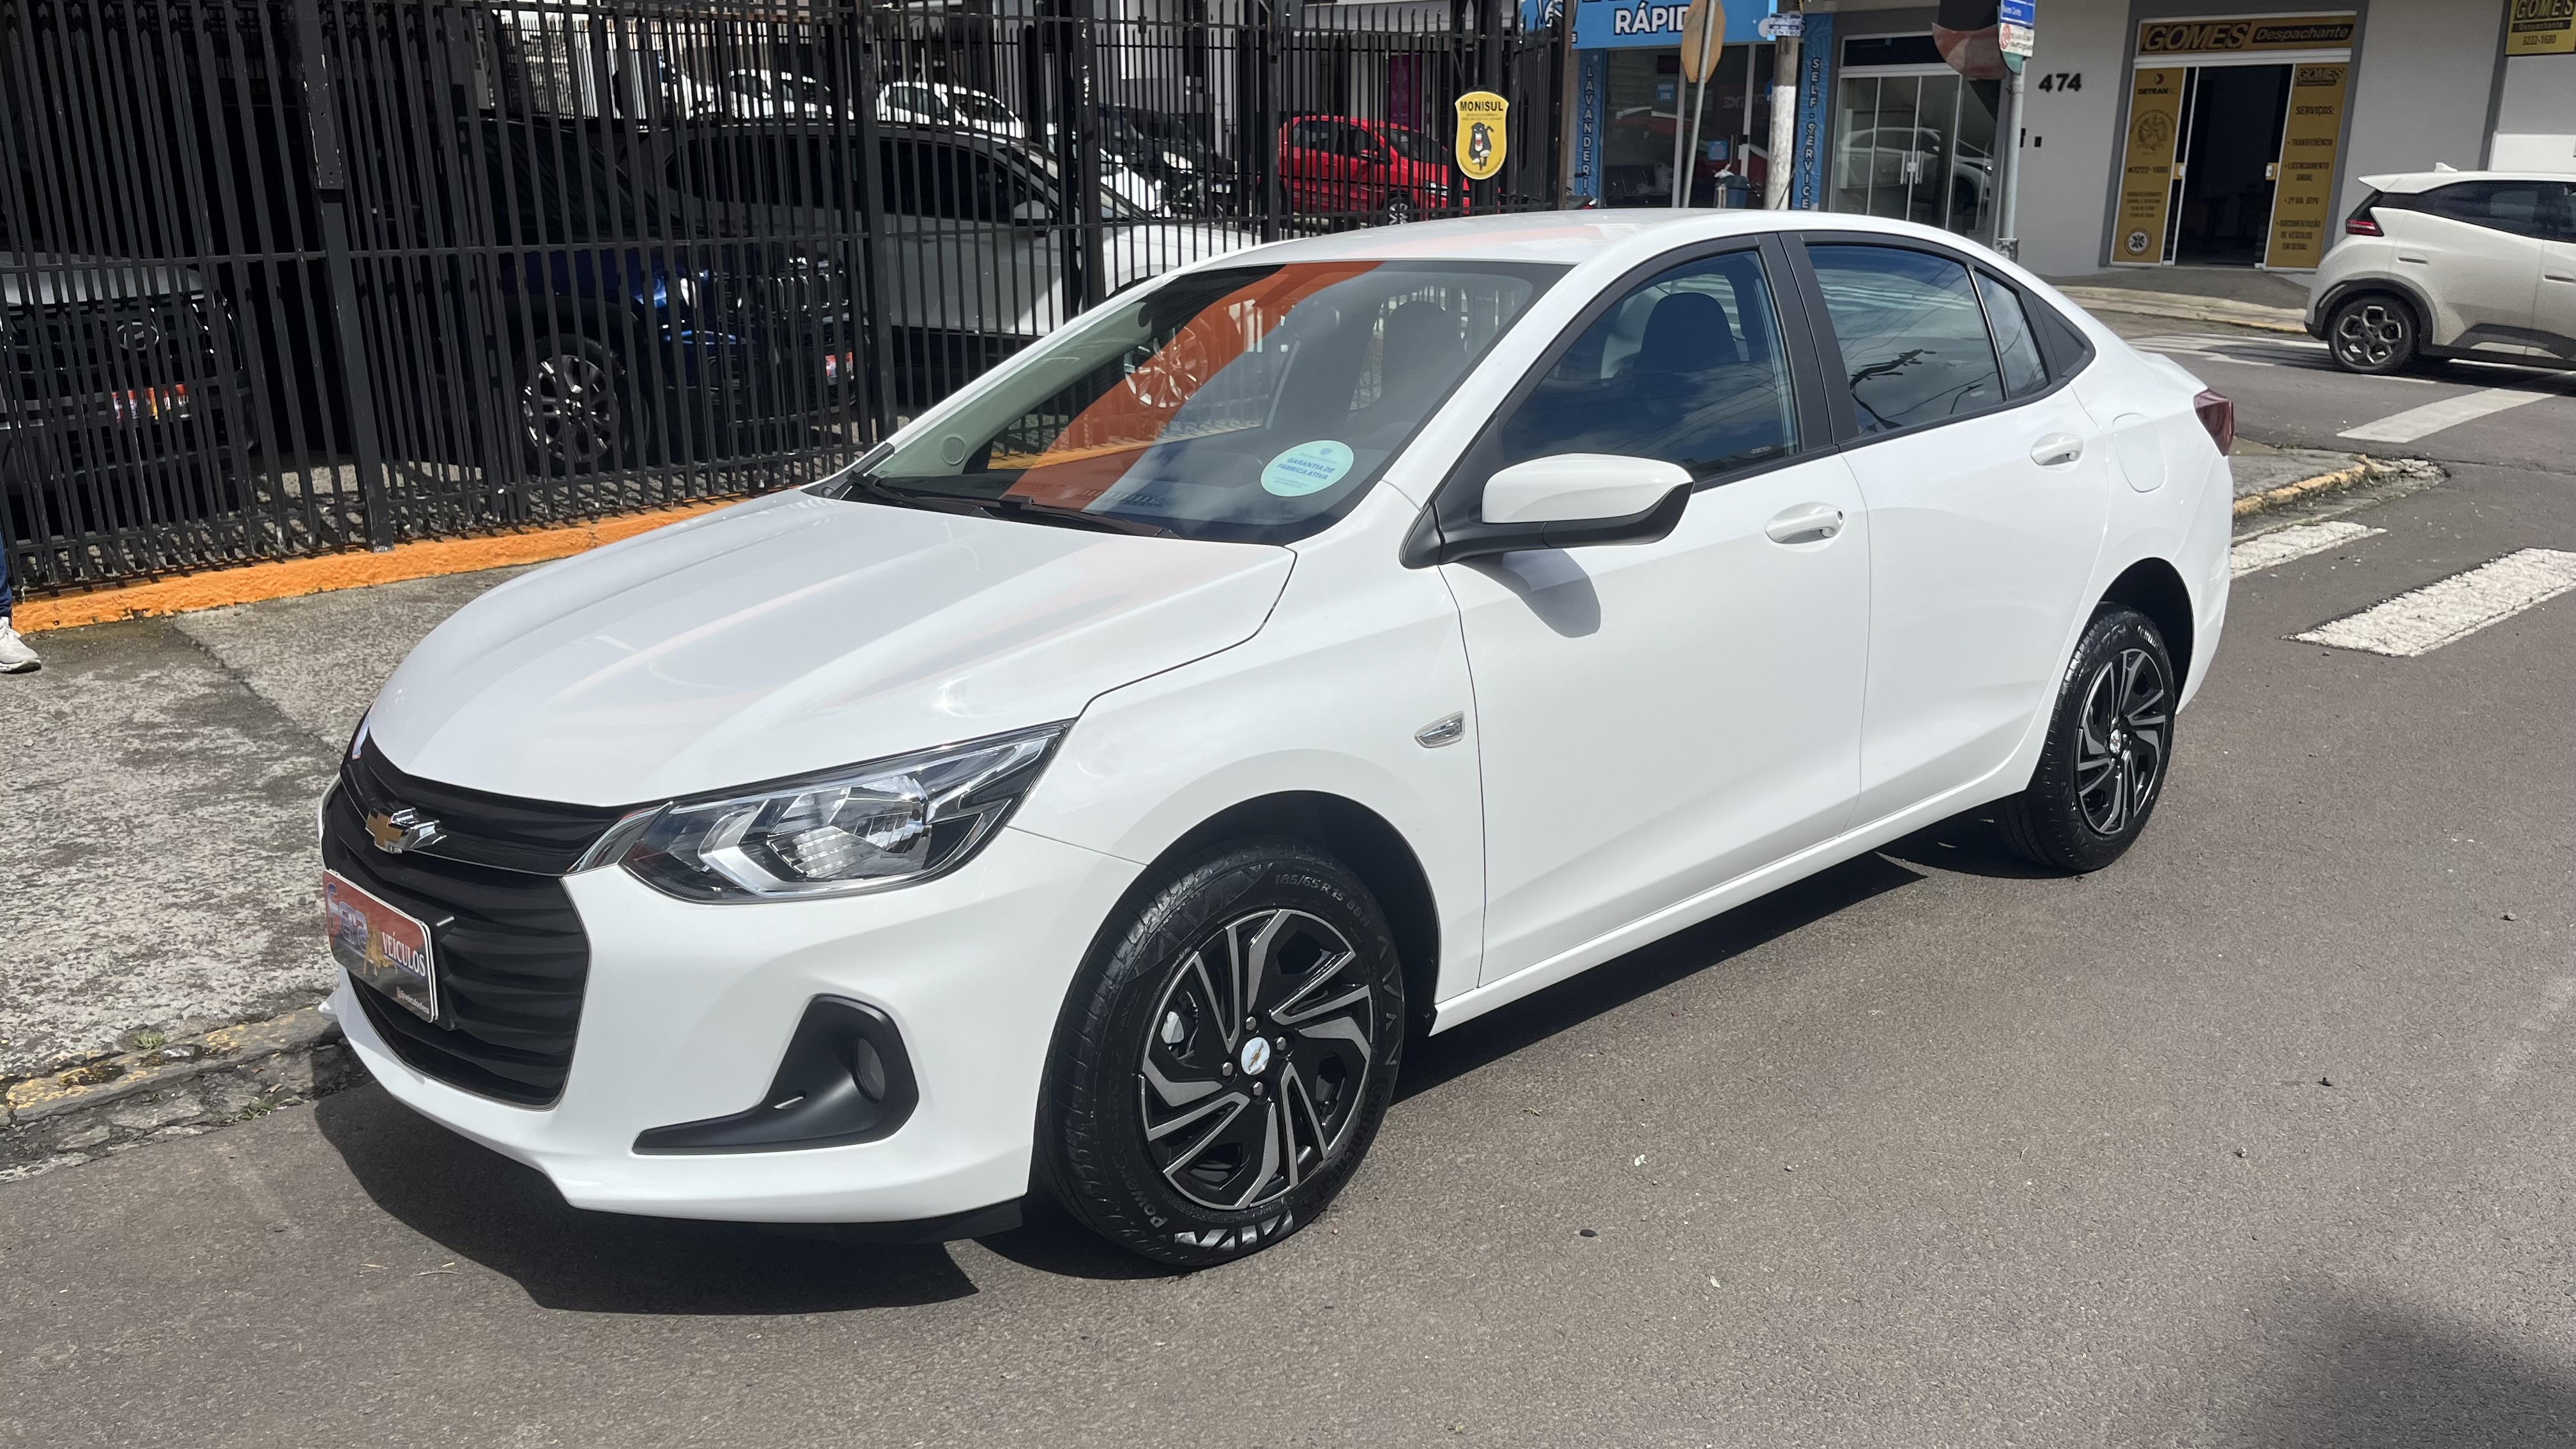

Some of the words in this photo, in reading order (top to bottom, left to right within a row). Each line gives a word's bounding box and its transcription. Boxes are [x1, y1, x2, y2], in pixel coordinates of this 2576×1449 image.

[1614, 1, 1690, 34] RÁPID
[2144, 21, 2251, 51] GOMES
[2256, 26, 2349, 42] Despachante
[2038, 73, 2082, 93] 474
[1460, 101, 1503, 111] MONISUL
[1581, 65, 1594, 197] LAVANDERI
[1287, 458, 1324, 471] GARANTIA
[1307, 472, 1328, 480] ATIVA
[1275, 874, 1321, 889] 185/65
[381, 931, 426, 977] VEÍCULOS
